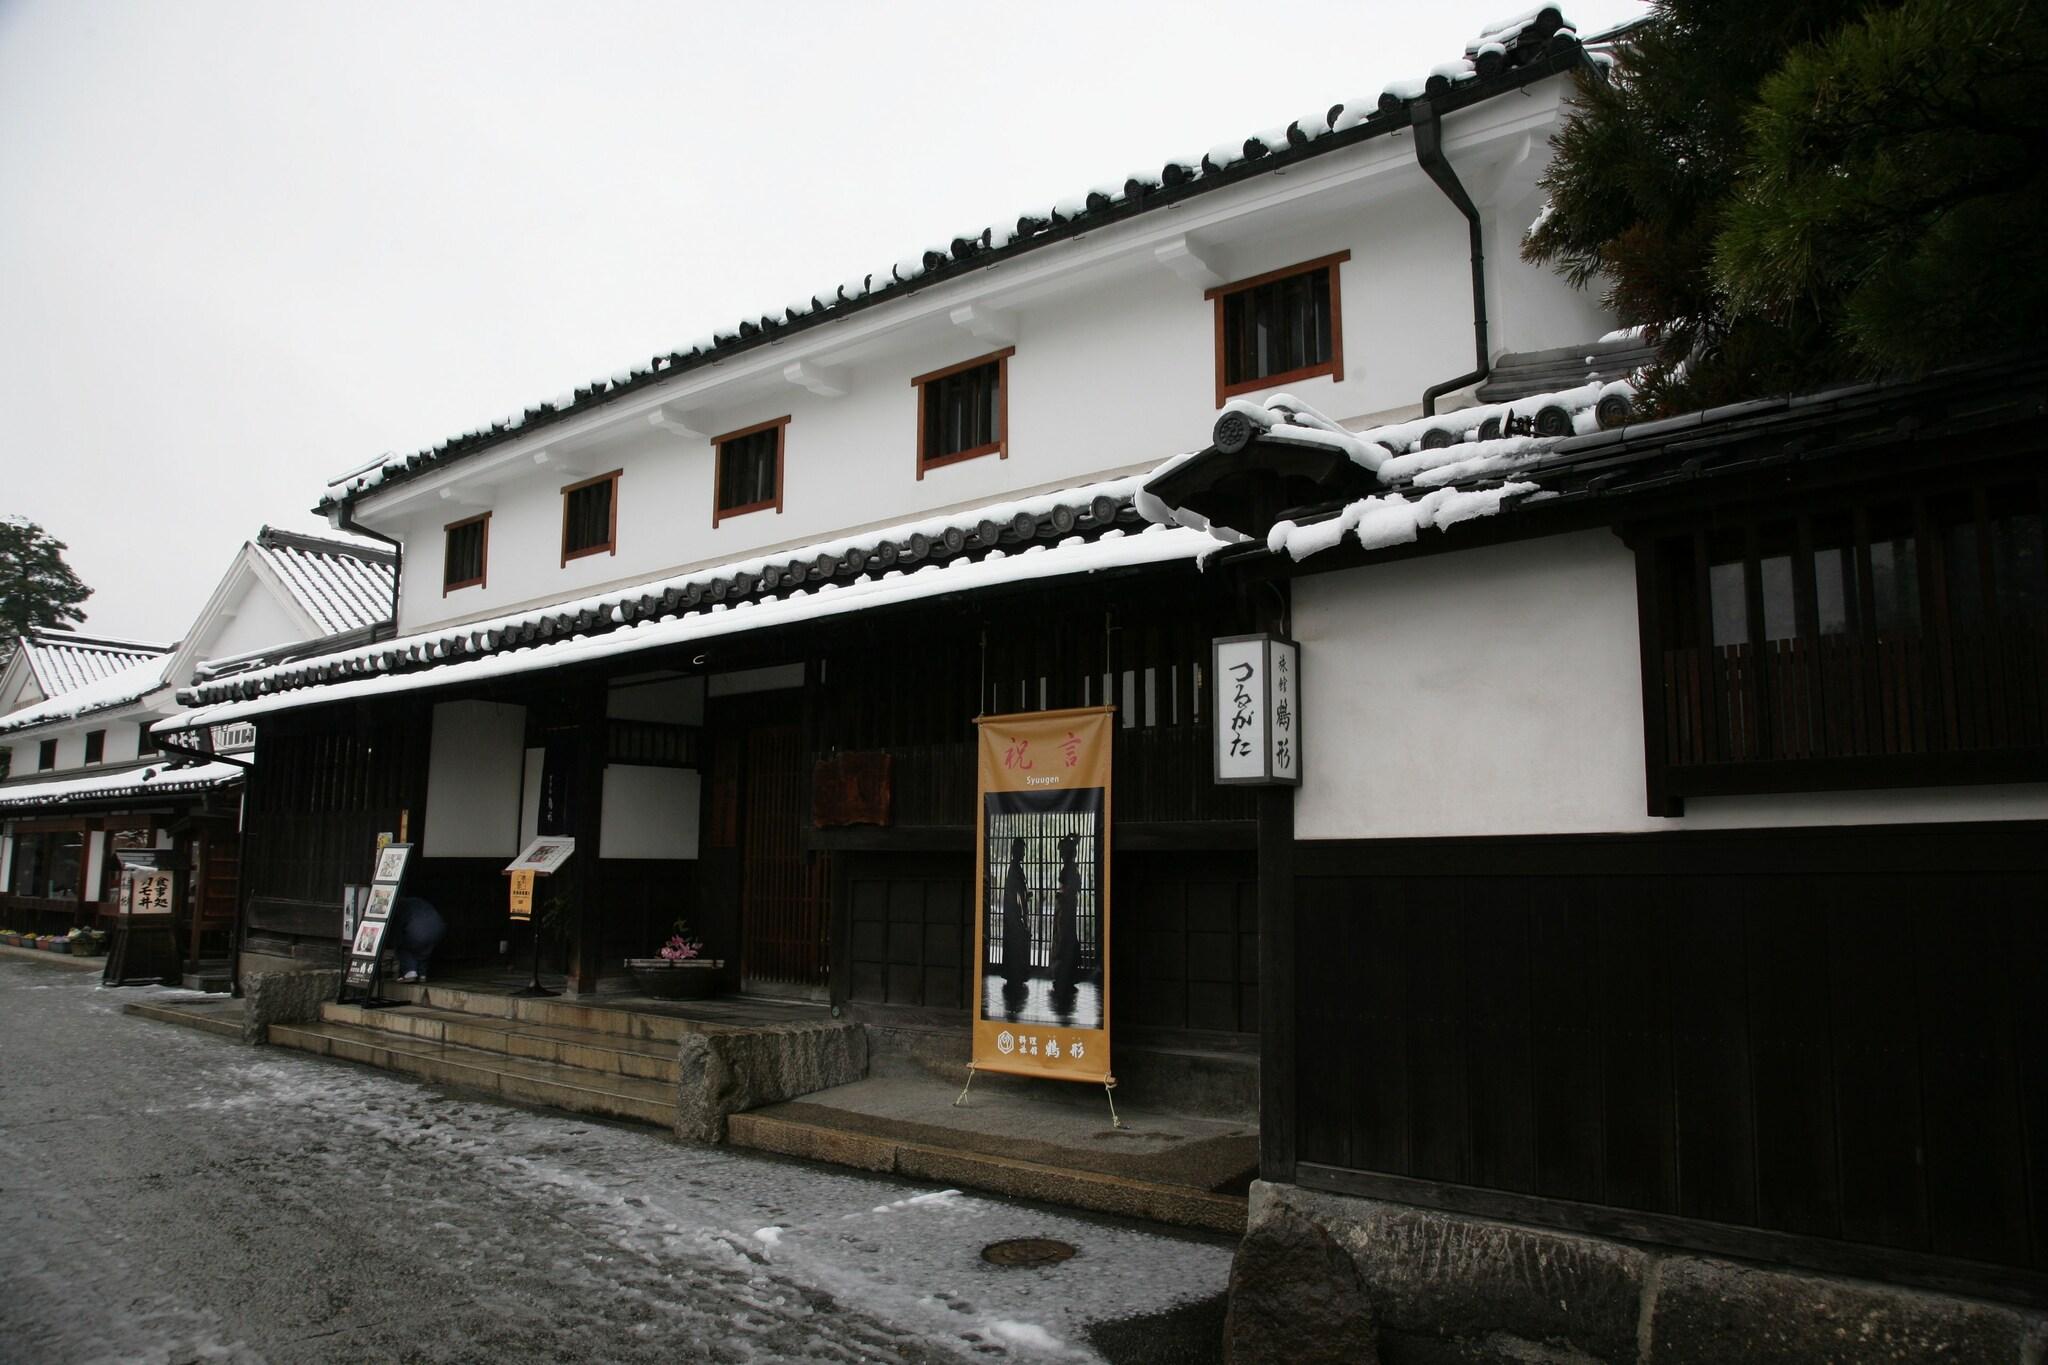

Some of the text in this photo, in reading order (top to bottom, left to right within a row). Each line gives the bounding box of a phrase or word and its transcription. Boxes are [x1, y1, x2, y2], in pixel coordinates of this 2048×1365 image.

[1228, 662, 1254, 757] つるがた
[1004, 731, 1082, 769] 祝言
[1026, 776, 1059, 785] Syuugen
[154, 876, 169, 908] 食事処
